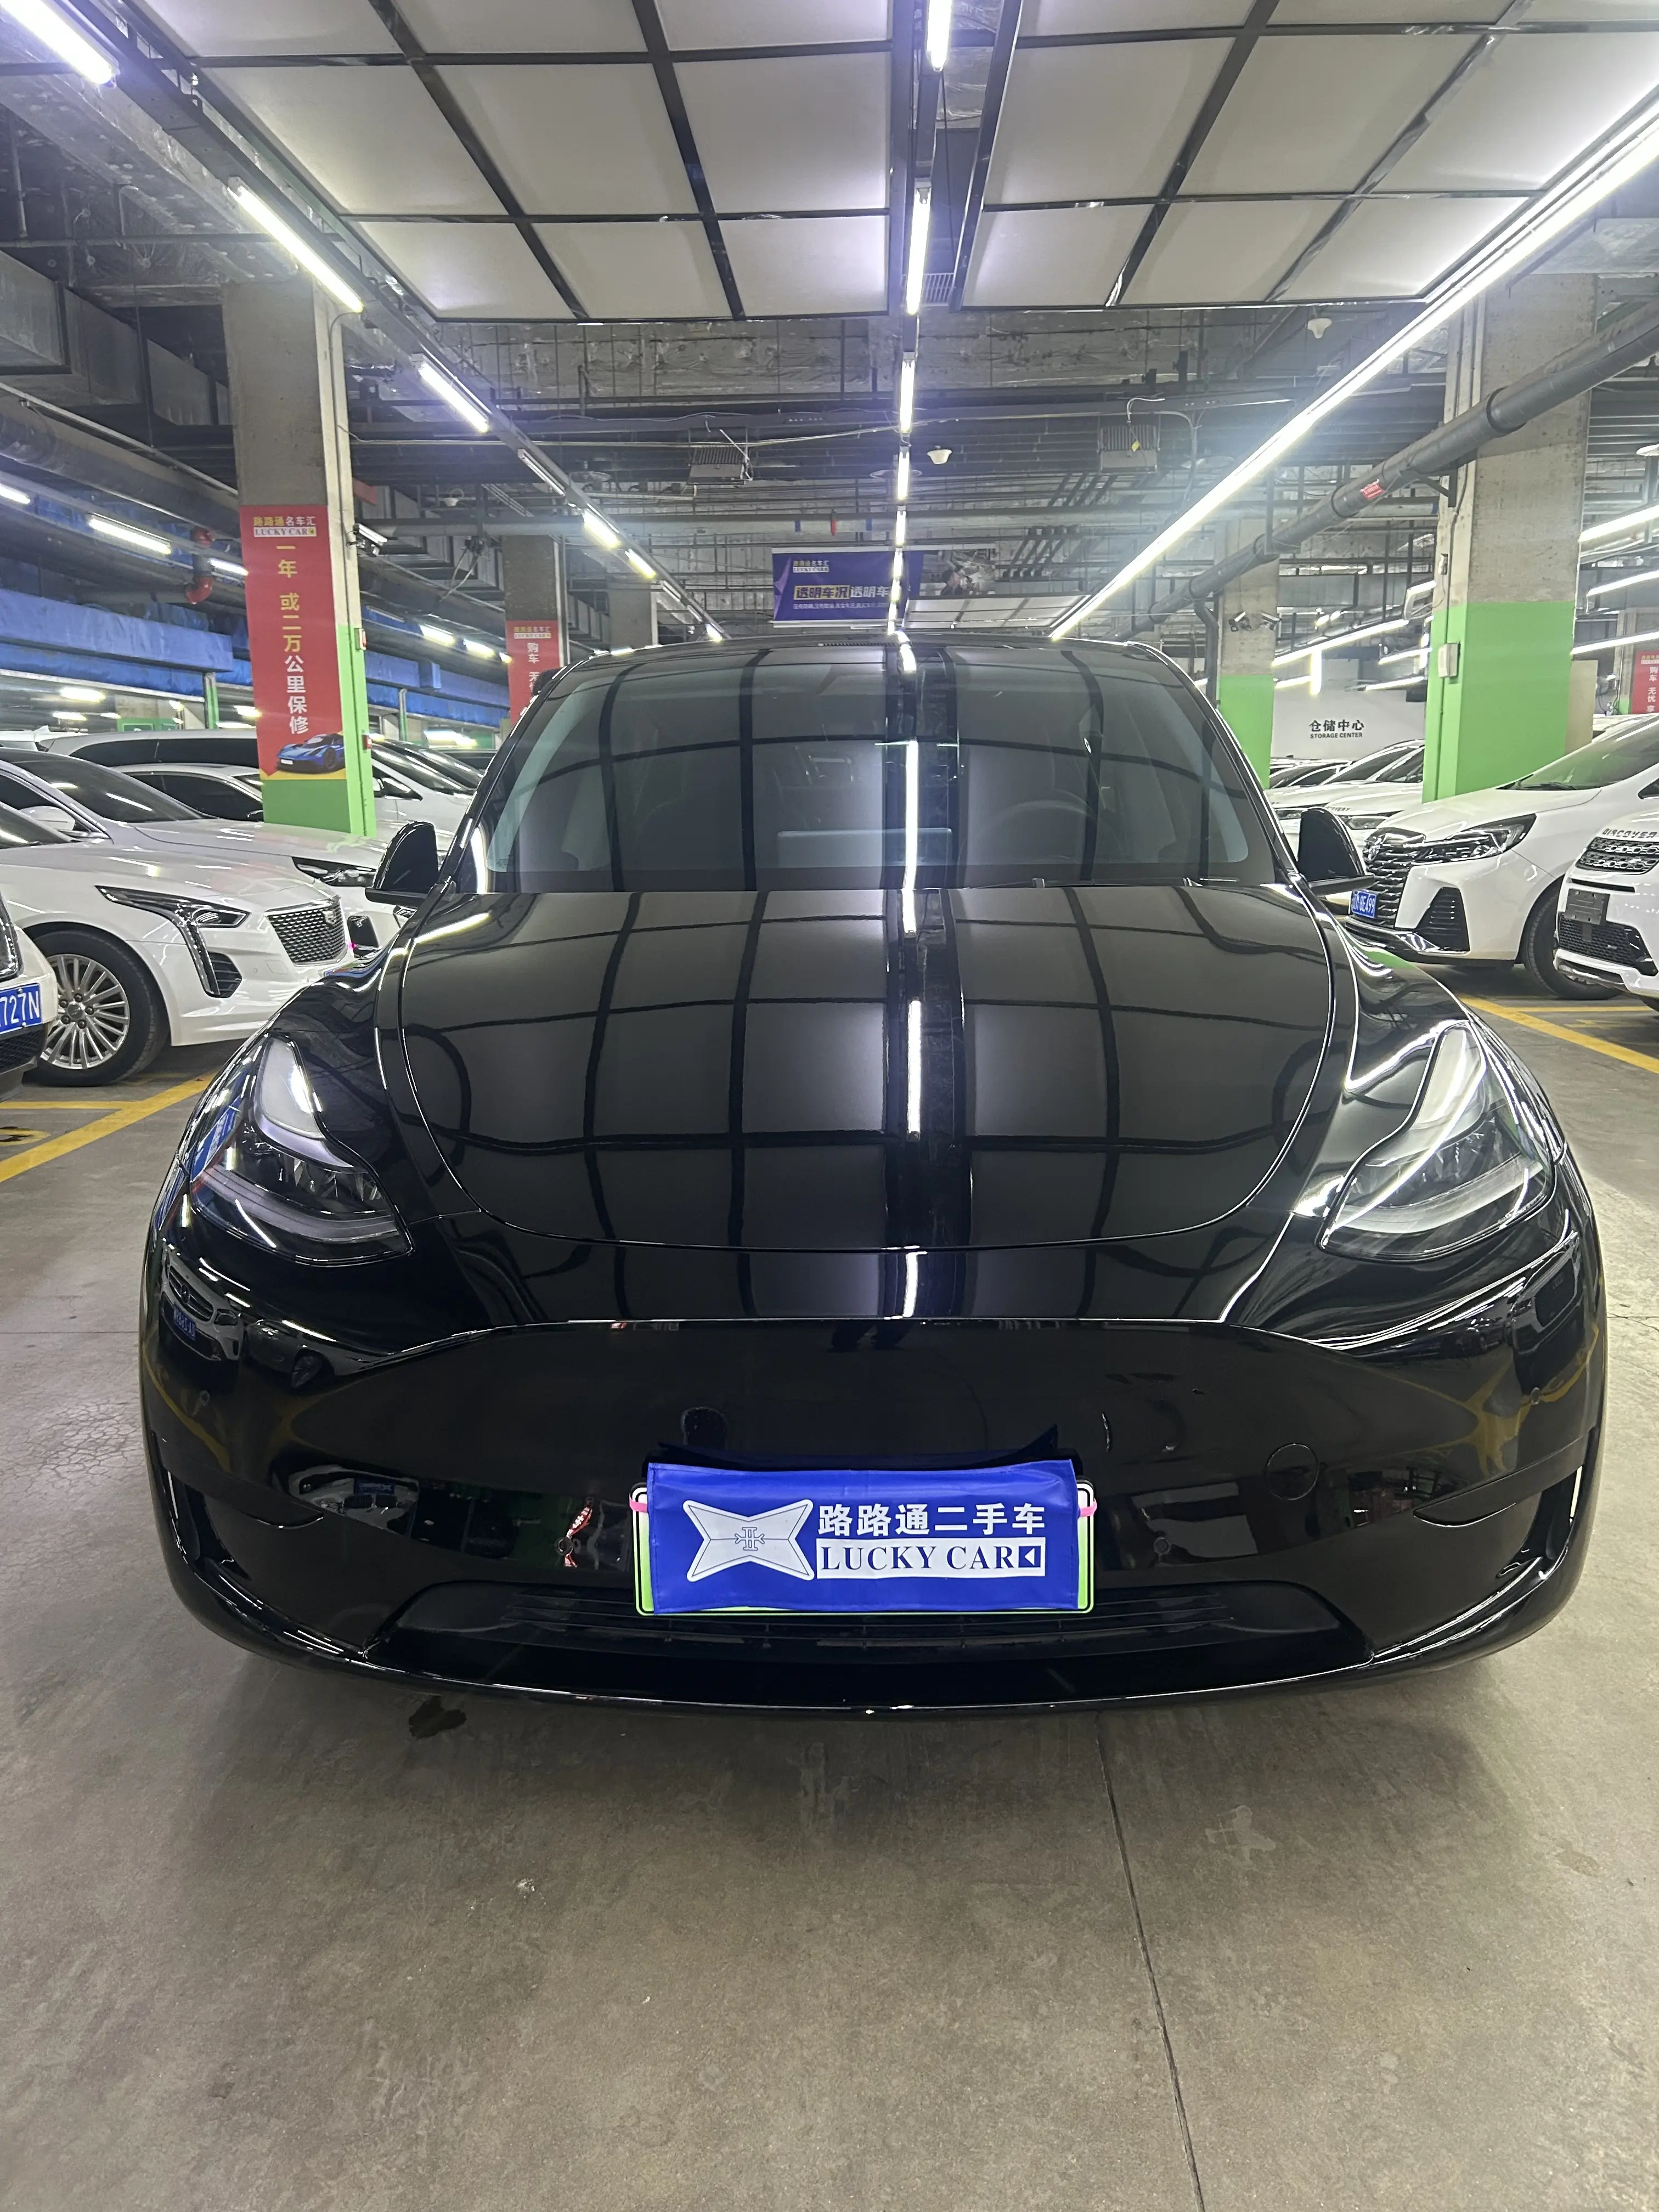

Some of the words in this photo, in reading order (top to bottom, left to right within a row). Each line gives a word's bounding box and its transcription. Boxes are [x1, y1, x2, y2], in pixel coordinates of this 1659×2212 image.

[797, 586, 892, 599] 透明车况透明车
[527, 642, 540, 664] 购车
[1309, 719, 1364, 732] 仓储中心
[0, 990, 40, 1026] 727N
[818, 1503, 1045, 1537] 路路通二手车
[821, 1546, 937, 1570] LUCKY
[946, 1546, 1014, 1570] CAR
